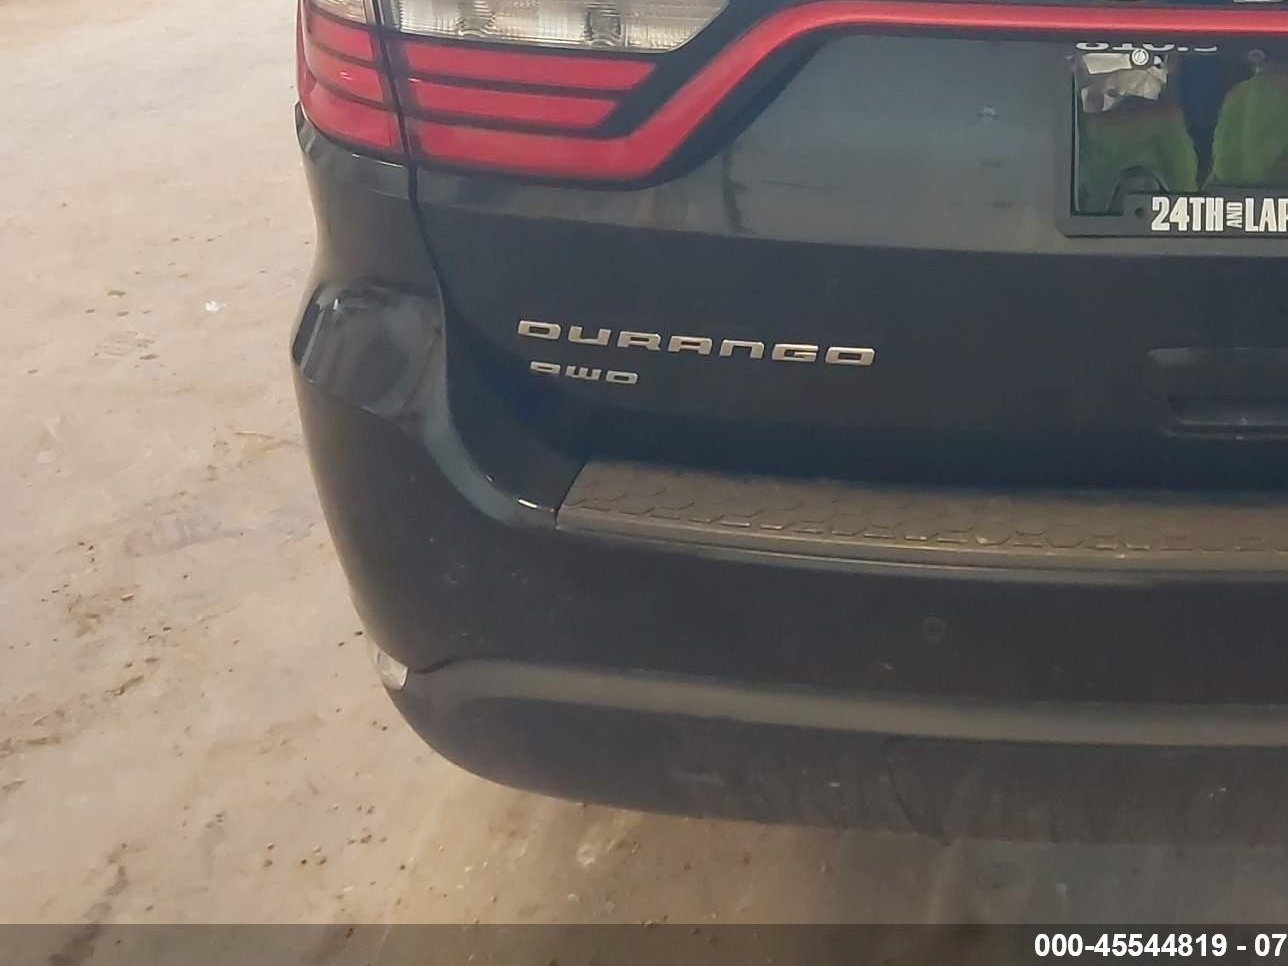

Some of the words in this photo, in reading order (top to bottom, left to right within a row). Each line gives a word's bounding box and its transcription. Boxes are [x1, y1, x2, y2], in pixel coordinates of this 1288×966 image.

[1151, 197, 1224, 232] 24TH
[1226, 201, 1243, 229] AND
[517, 320, 876, 366] DURANGO
[530, 361, 639, 384] AWD
